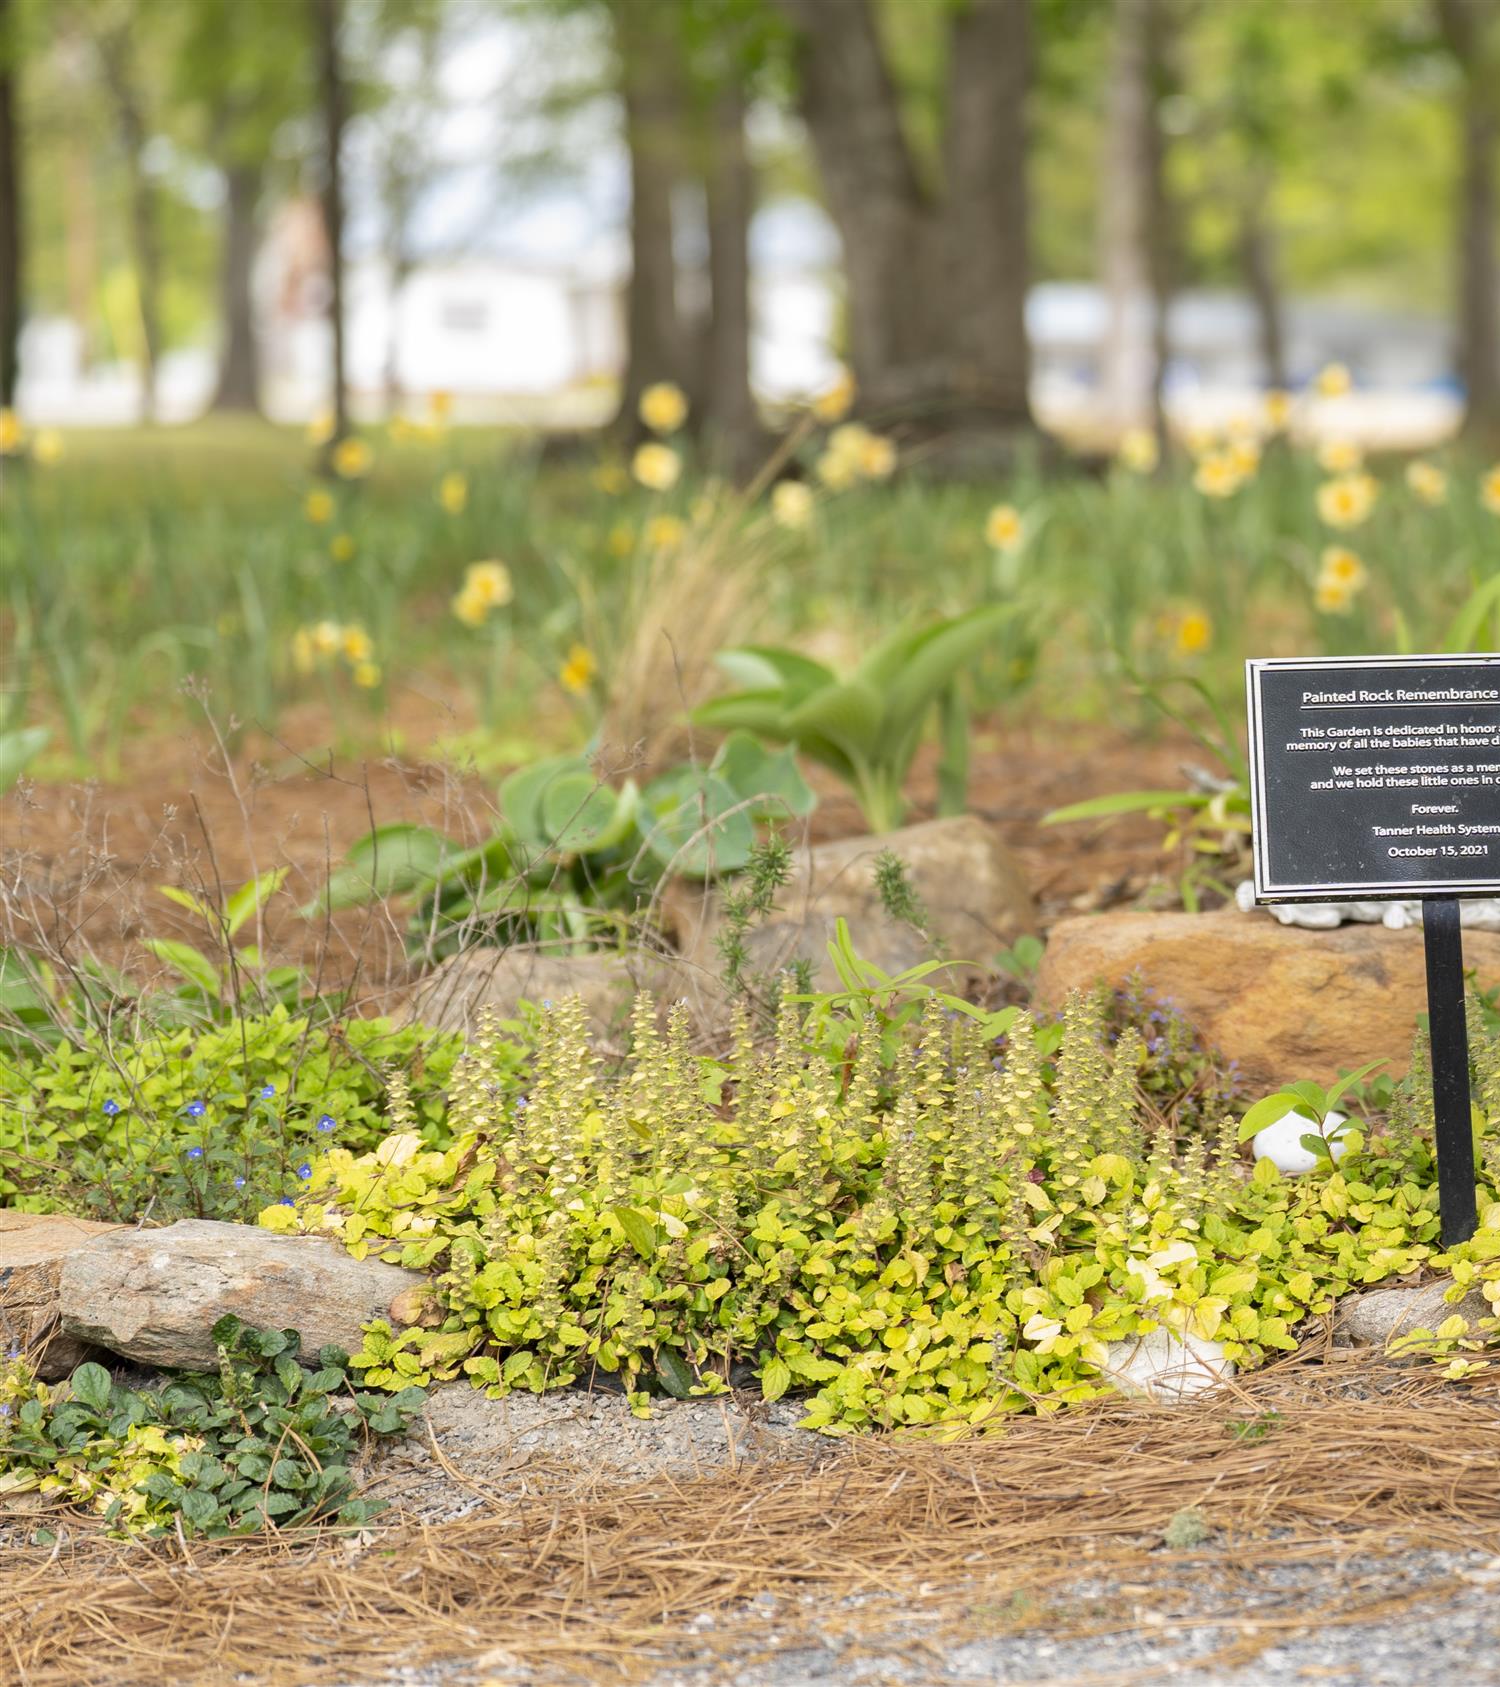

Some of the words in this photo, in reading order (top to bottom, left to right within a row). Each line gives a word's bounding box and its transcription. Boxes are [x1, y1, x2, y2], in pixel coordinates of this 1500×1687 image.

[1303, 691, 1356, 703] Painted
[1359, 690, 1394, 702] Rock
[1396, 689, 1498, 701] Remembrance
[1300, 728, 1325, 738] This
[1327, 728, 1371, 737] Garden
[1372, 726, 1383, 736] is
[1385, 725, 1444, 736] dedicated
[1446, 724, 1458, 734] in
[1460, 724, 1497, 734] honor
[1286, 741, 1336, 752] memory
[1339, 739, 1352, 749] of
[1353, 739, 1368, 749] all
[1370, 738, 1390, 748] the
[1392, 738, 1431, 748] babies
[1433, 737, 1458, 747] that
[1461, 736, 1488, 746] have
[1333, 766, 1352, 776] We
[1354, 766, 1373, 776] set
[1374, 765, 1407, 774] these
[1410, 764, 1448, 774] stones
[1310, 780, 1333, 790] and
[1336, 781, 1353, 789] we
[1356, 778, 1383, 788] hold
[1386, 777, 1418, 787] these
[1420, 776, 1448, 786] little
[1450, 777, 1479, 785] ones
[1482, 775, 1492, 785] in
[1412, 804, 1458, 814] Forever.
[1373, 826, 1414, 836] Tanner
[1416, 825, 1455, 835] Health
[1458, 824, 1500, 836] System
[1388, 846, 1436, 857] October
[1440, 846, 1458, 858] 15,
[1460, 846, 1488, 856] 2021
